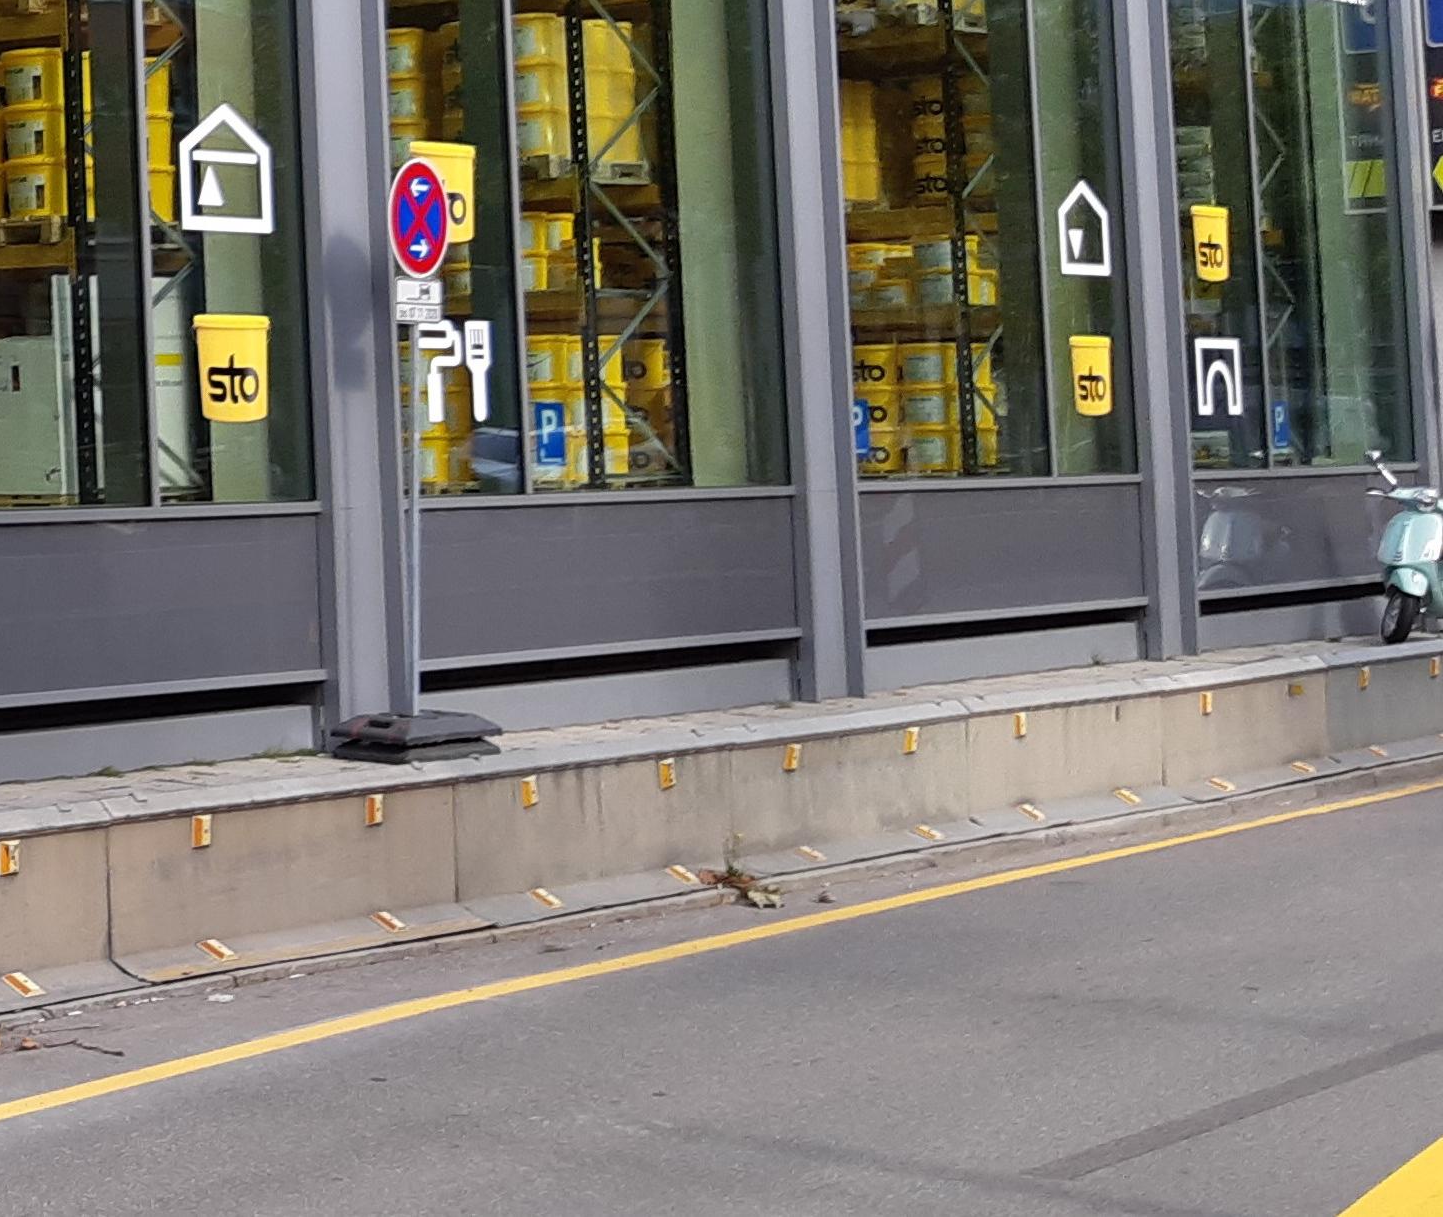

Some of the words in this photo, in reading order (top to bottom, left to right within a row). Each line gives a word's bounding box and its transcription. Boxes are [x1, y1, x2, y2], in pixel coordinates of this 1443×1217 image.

[1198, 233, 1225, 268] sto
[206, 353, 260, 405] sto
[1078, 366, 1107, 402] sto
[541, 409, 558, 444] P
